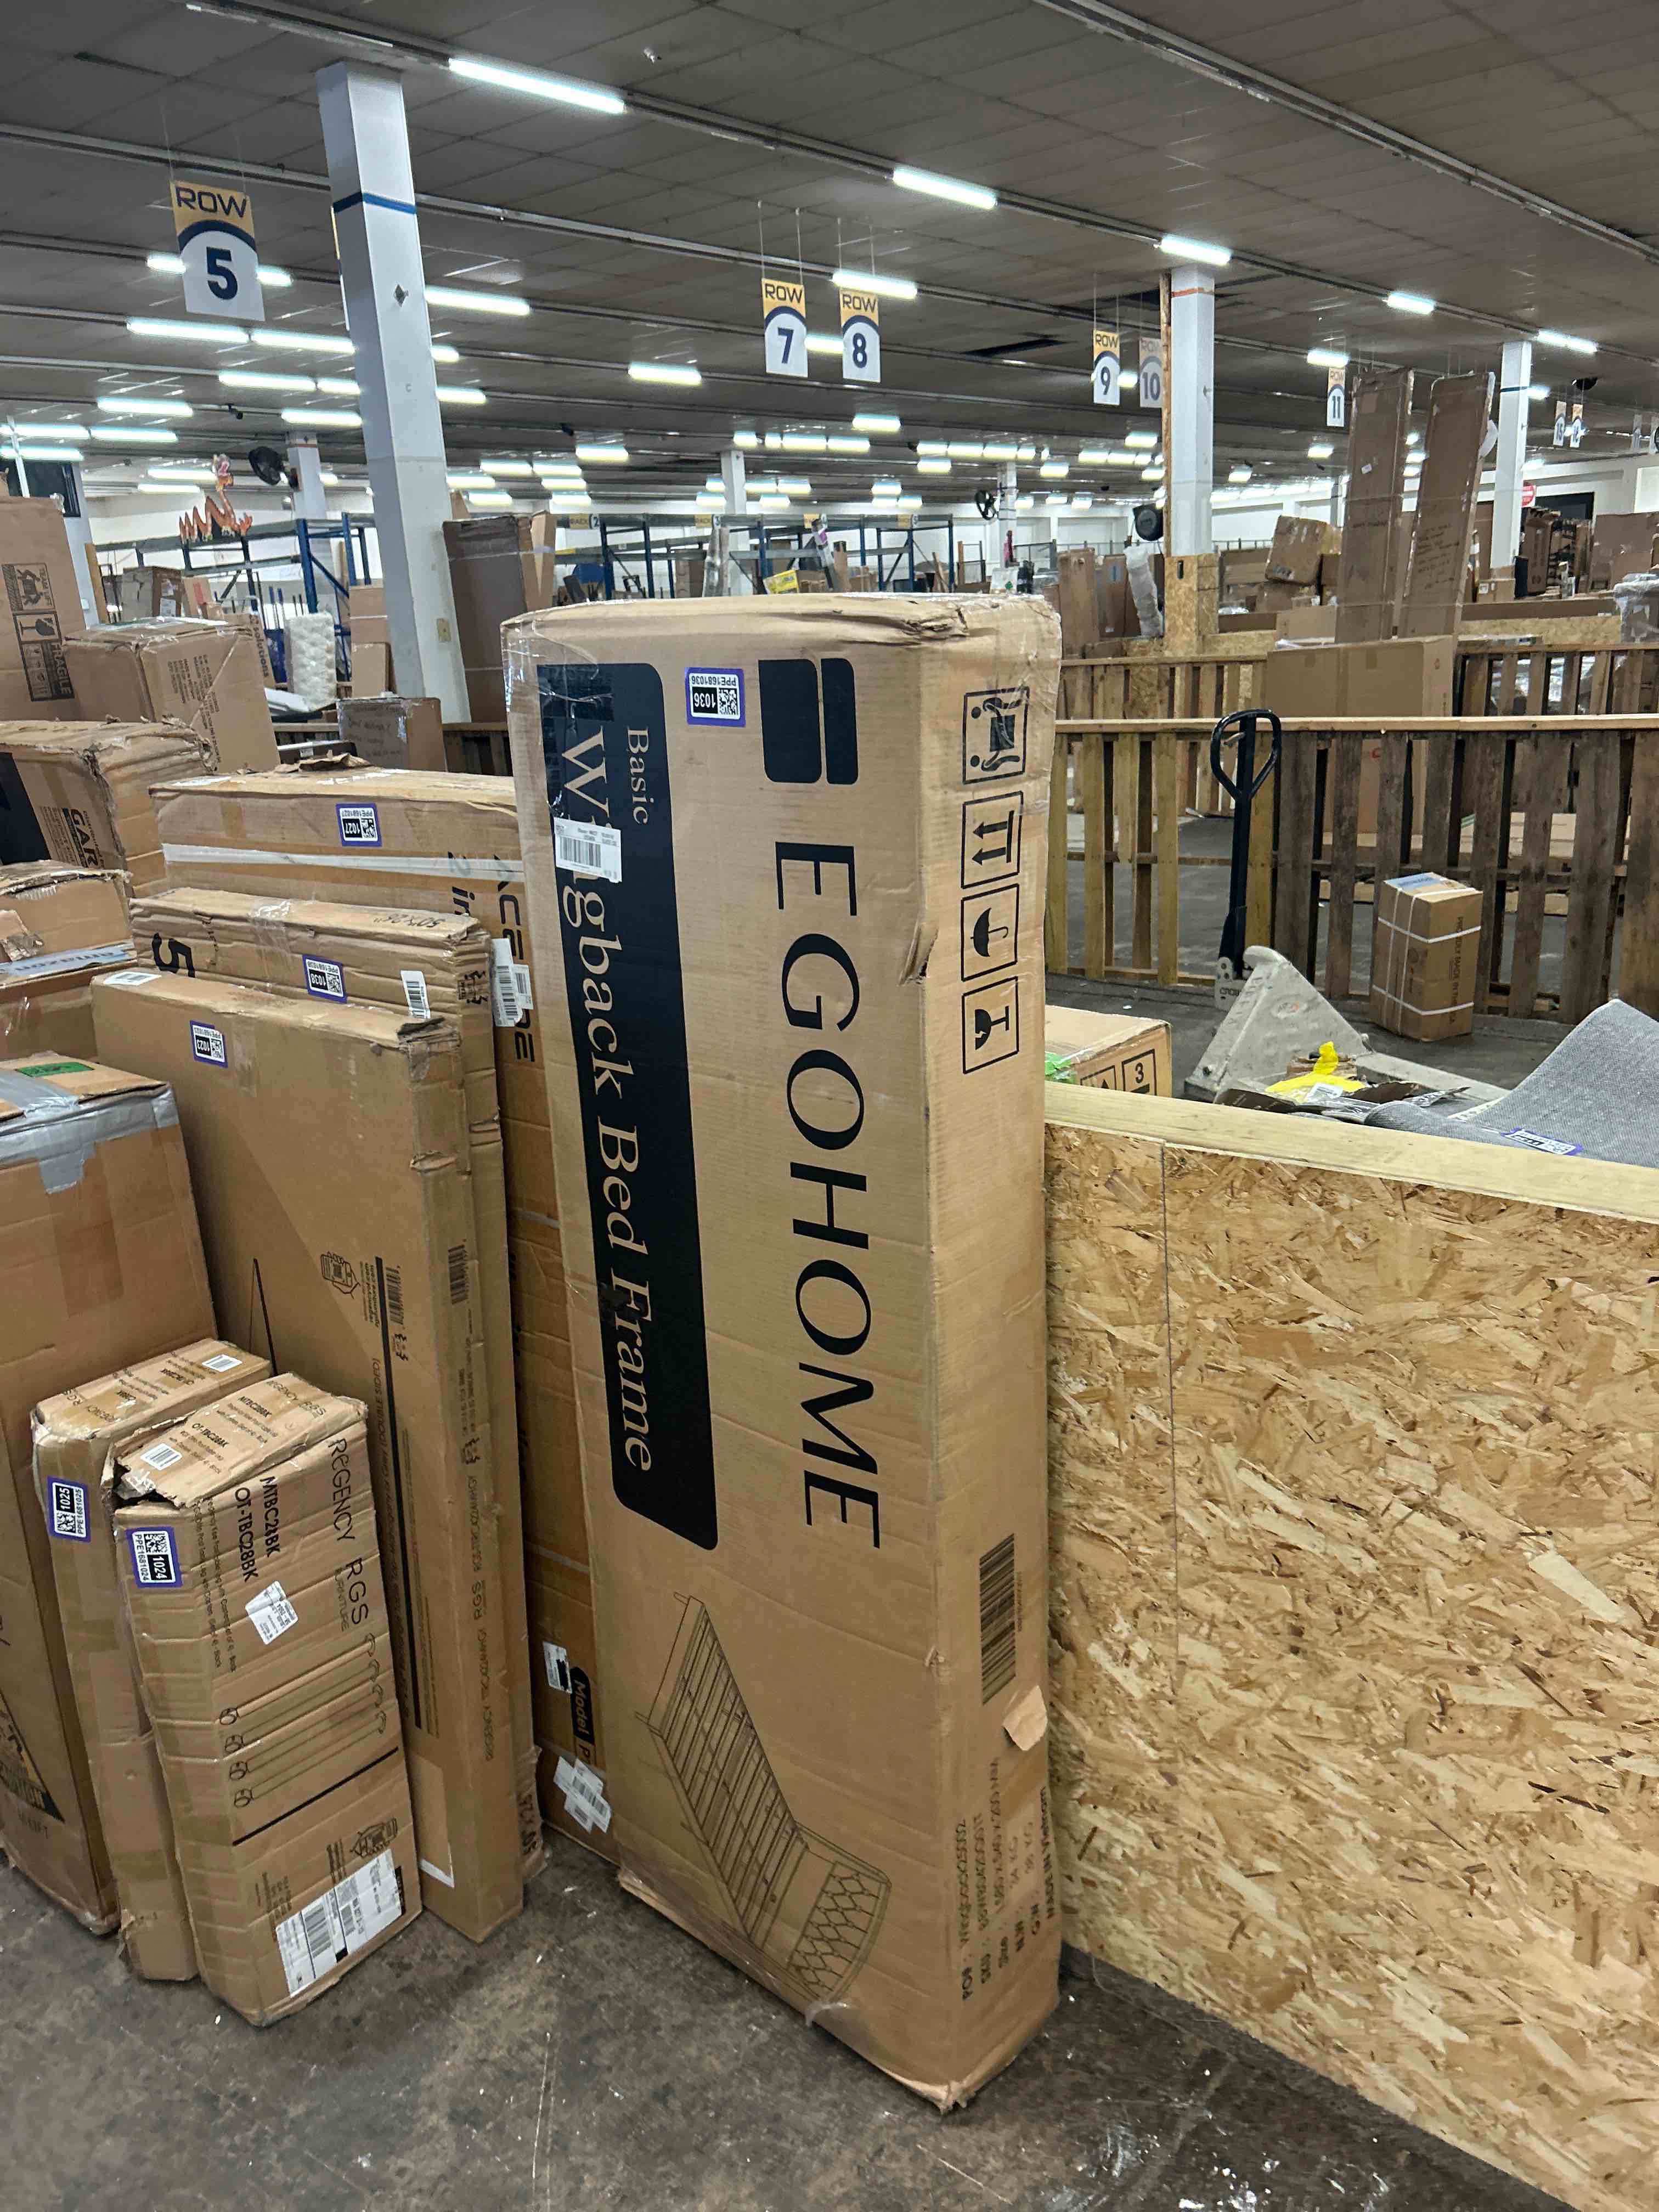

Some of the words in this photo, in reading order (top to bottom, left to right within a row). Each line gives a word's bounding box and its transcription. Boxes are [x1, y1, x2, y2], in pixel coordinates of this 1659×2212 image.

[175, 185, 247, 218] ROW
[206, 246, 238, 301] 5
[764, 283, 804, 304] ROW
[841, 292, 878, 313] ROW
[776, 327, 794, 364] 7
[851, 332, 868, 369] 8
[1094, 332, 1119, 348] ROW
[1140, 337, 1161, 353] ROW
[1101, 365, 1110, 396] 9
[1142, 371, 1161, 400] 10
[1331, 396, 1341, 419] 11
[51, 642, 74, 695] FRAGILE
[254, 626, 270, 678] solutions
[691, 675, 737, 686] PPE1681036
[693, 692, 716, 709] 1036
[627, 726, 654, 824] Basic
[345, 822, 360, 834] 1027
[561, 725, 635, 1099] Wgback
[1453, 916, 1464, 954] PRODLY
[196, 1038, 210, 1054] 1023
[1135, 1062, 1145, 1085] 3
[597, 1115, 648, 1256] Bed
[775, 841, 881, 1549] EGOHOME
[610, 1266, 653, 1472] Frame
[59, 1487, 72, 1510] 1025
[74, 1488, 84, 1535] PPE1681025
[234, 1485, 259, 1583] OT-TBC28BK
[133, 1533, 150, 1582] PPE1681024
[152, 1555, 167, 1580] 1024
[344, 1557, 369, 1626] RGS
[473, 1581, 483, 1620] RGS
[572, 1679, 590, 1735] Model
